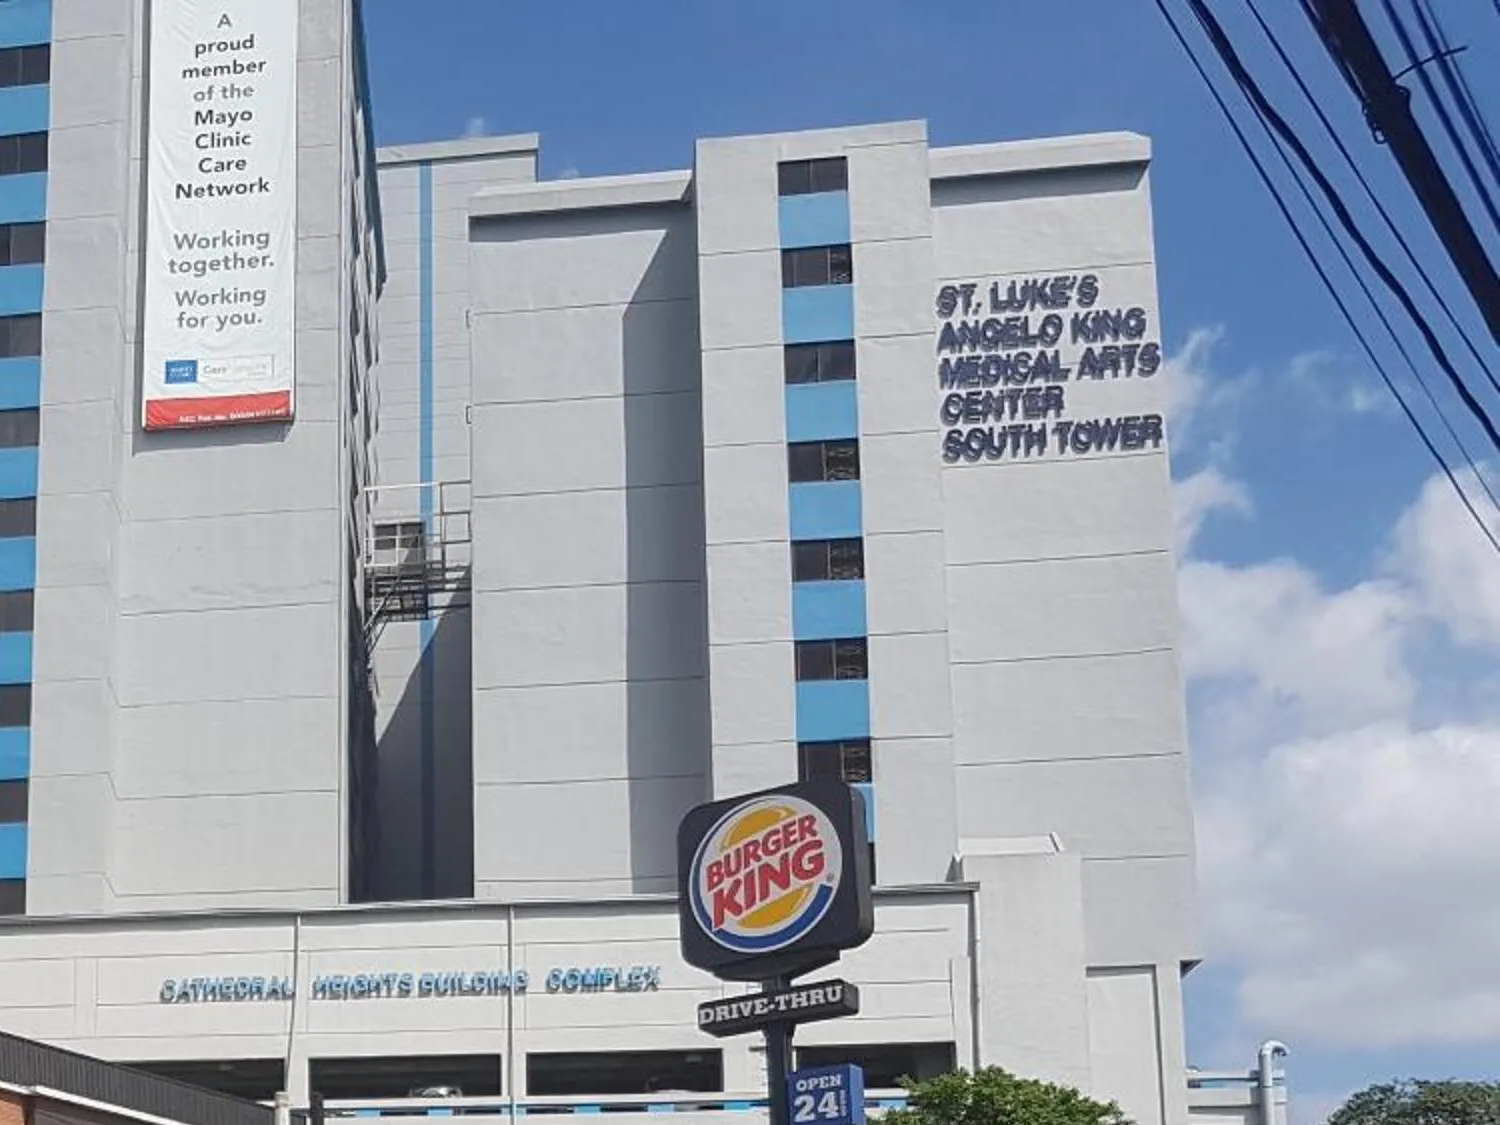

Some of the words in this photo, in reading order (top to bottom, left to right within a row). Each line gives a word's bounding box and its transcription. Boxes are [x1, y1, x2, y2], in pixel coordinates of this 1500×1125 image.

[217, 13, 232, 28] A
[195, 33, 254, 58] proud
[182, 59, 266, 78] member
[193, 84, 214, 101] of
[221, 83, 254, 99] the
[195, 109, 253, 128] Mayo
[195, 131, 252, 149] Clinic
[198, 157, 247, 173] Care
[175, 176, 270, 199] Network
[173, 229, 270, 250] Working
[168, 251, 274, 277] together.
[175, 287, 266, 307] Working
[936, 283, 982, 319] ST.
[990, 274, 1099, 315] LUKE'S
[177, 311, 208, 328] for
[216, 312, 262, 332] you.
[937, 313, 1063, 355] ANGELO
[1070, 307, 1147, 345] KING
[938, 350, 1071, 390] MEDICAL
[1076, 342, 1161, 381] ARTS
[940, 385, 1064, 426] CENTER
[942, 422, 1047, 463] SOUTH
[1052, 413, 1163, 455] TOWER
[706, 814, 818, 893] BURGER
[712, 838, 825, 930] KING
[159, 975, 297, 1004] CATHEDRAL
[311, 972, 413, 1001] HEIGHTS
[545, 966, 661, 993] COMPLEX
[699, 985, 843, 1025] DRIVE-THRU
[796, 1073, 842, 1092] OPEN
[794, 1091, 839, 1122] 24
